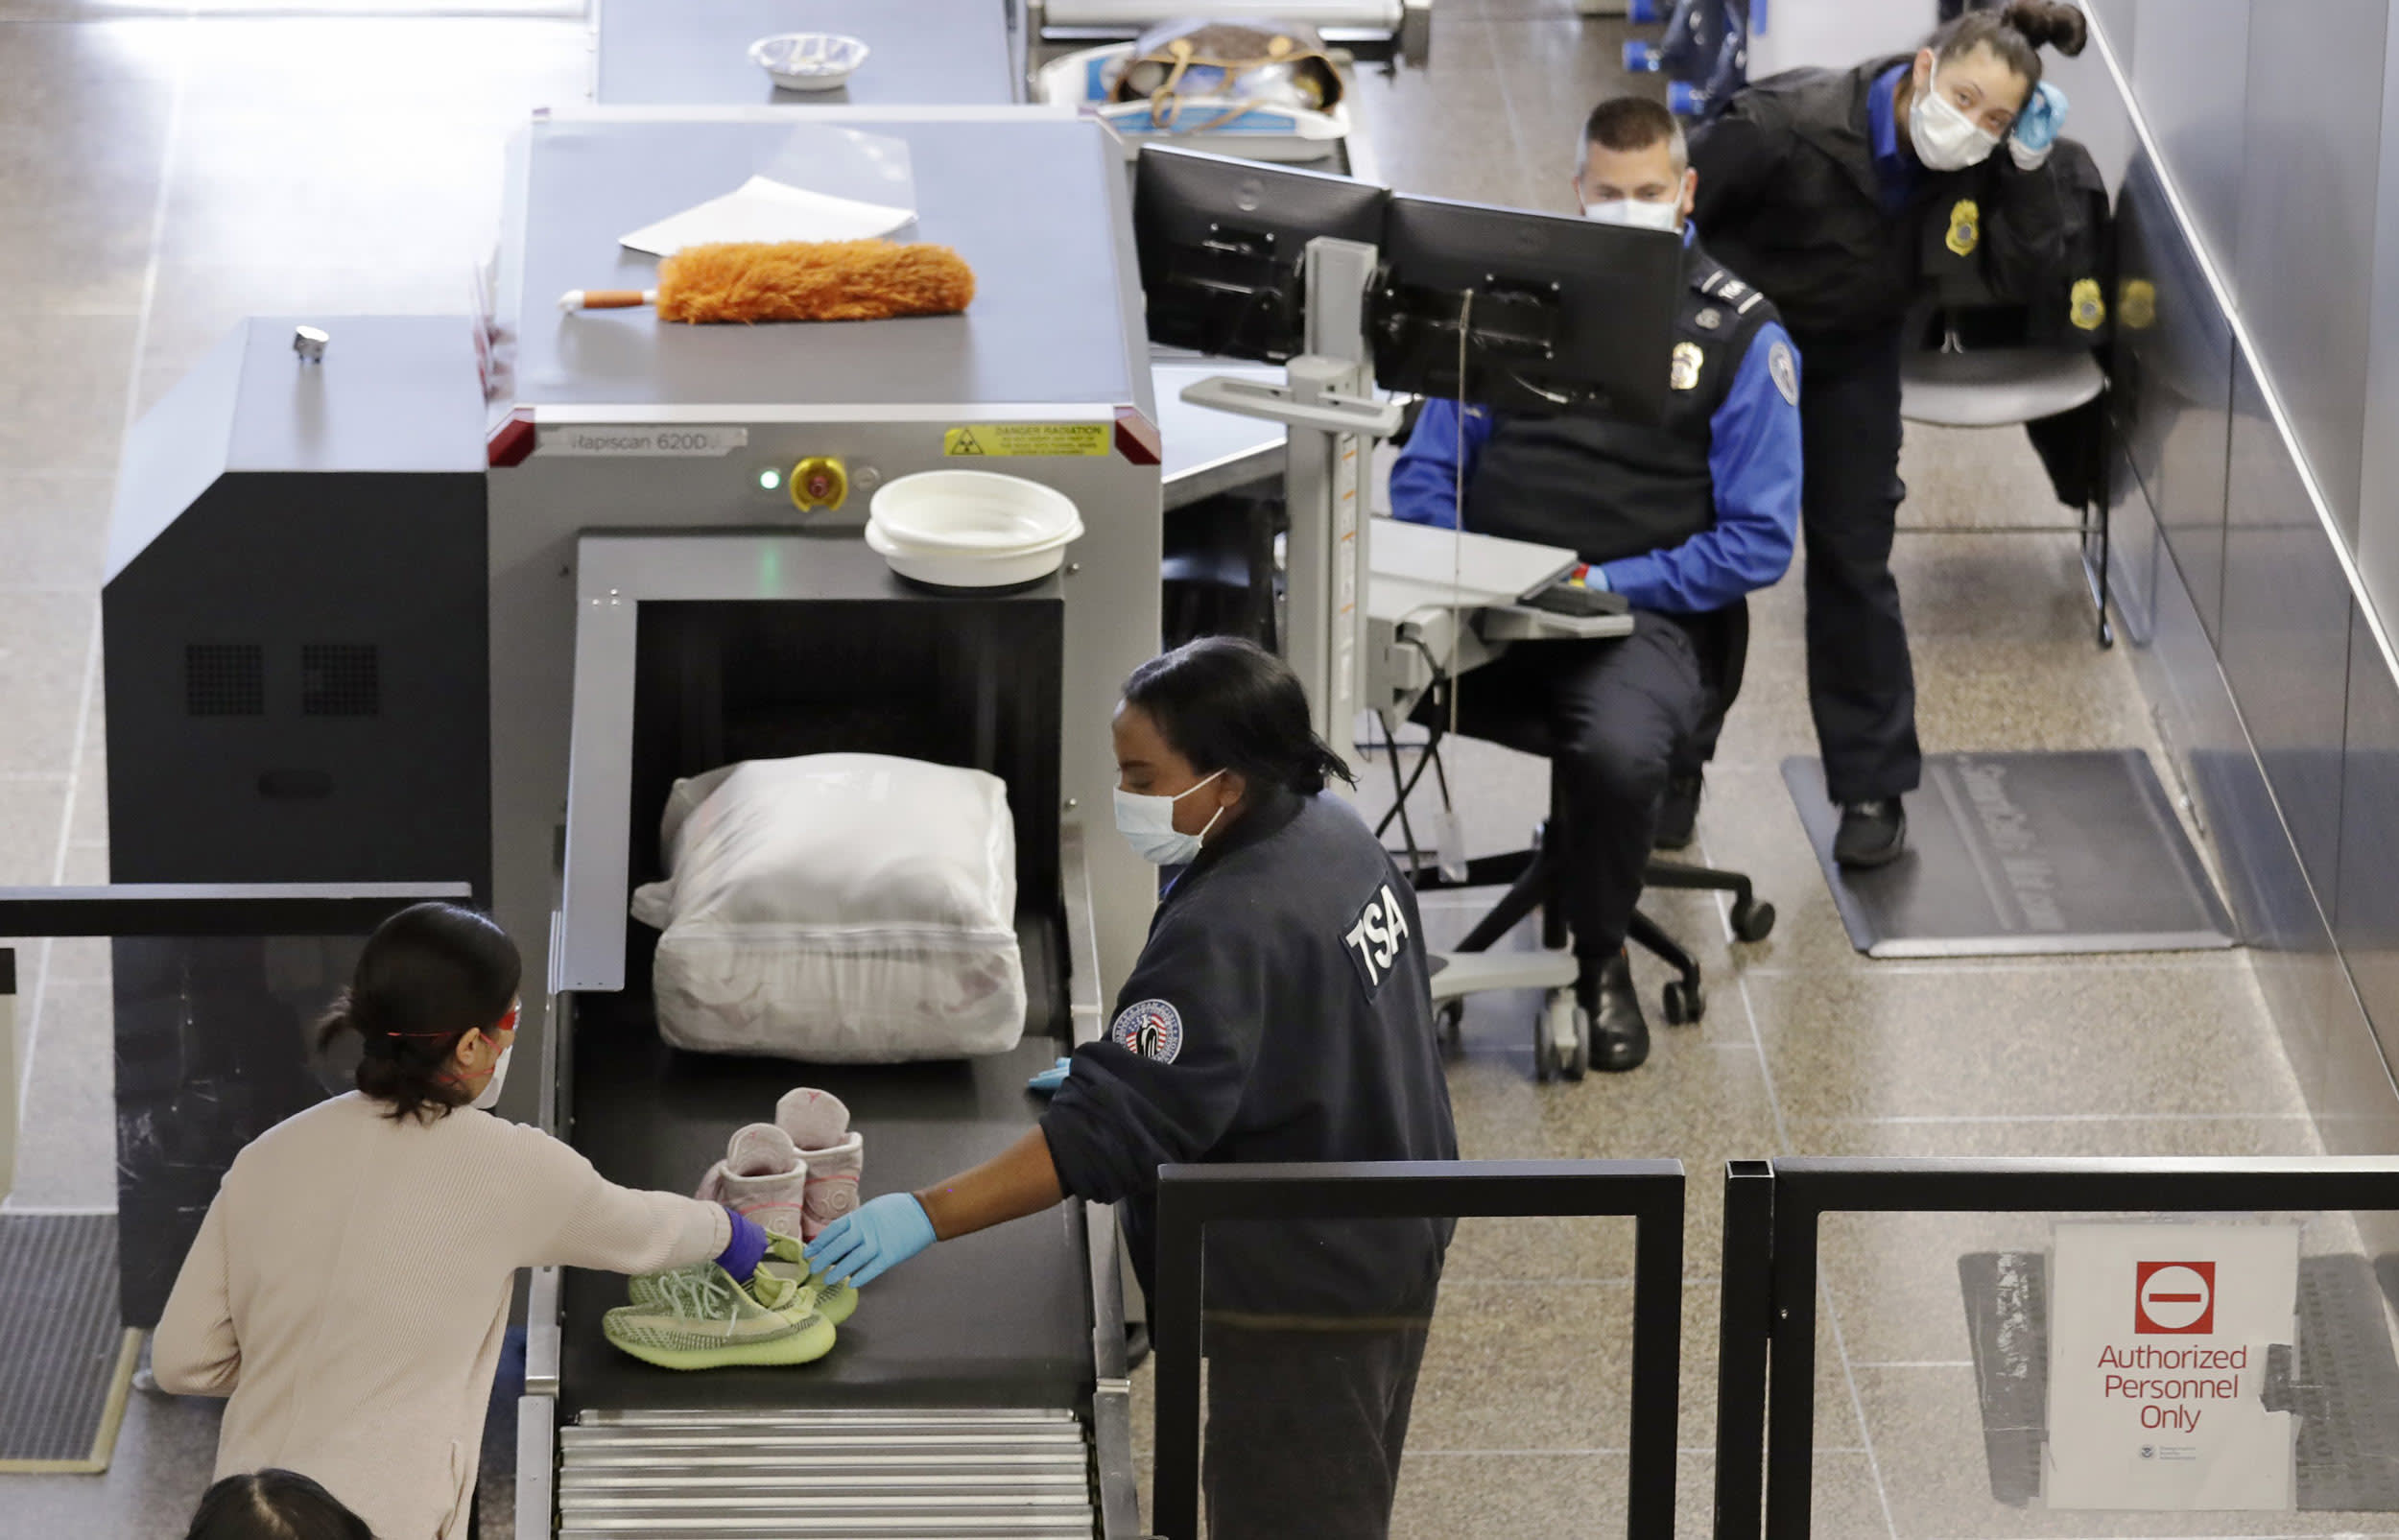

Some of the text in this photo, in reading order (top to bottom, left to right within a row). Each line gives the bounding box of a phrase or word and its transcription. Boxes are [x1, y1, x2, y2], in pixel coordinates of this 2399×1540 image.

[656, 433, 721, 451] 620D
[1345, 884, 1409, 986] TSA
[2098, 1344, 2247, 1369] Authorized
[2104, 1374, 2239, 1399] Personnel
[2141, 1404, 2201, 1433] Only
